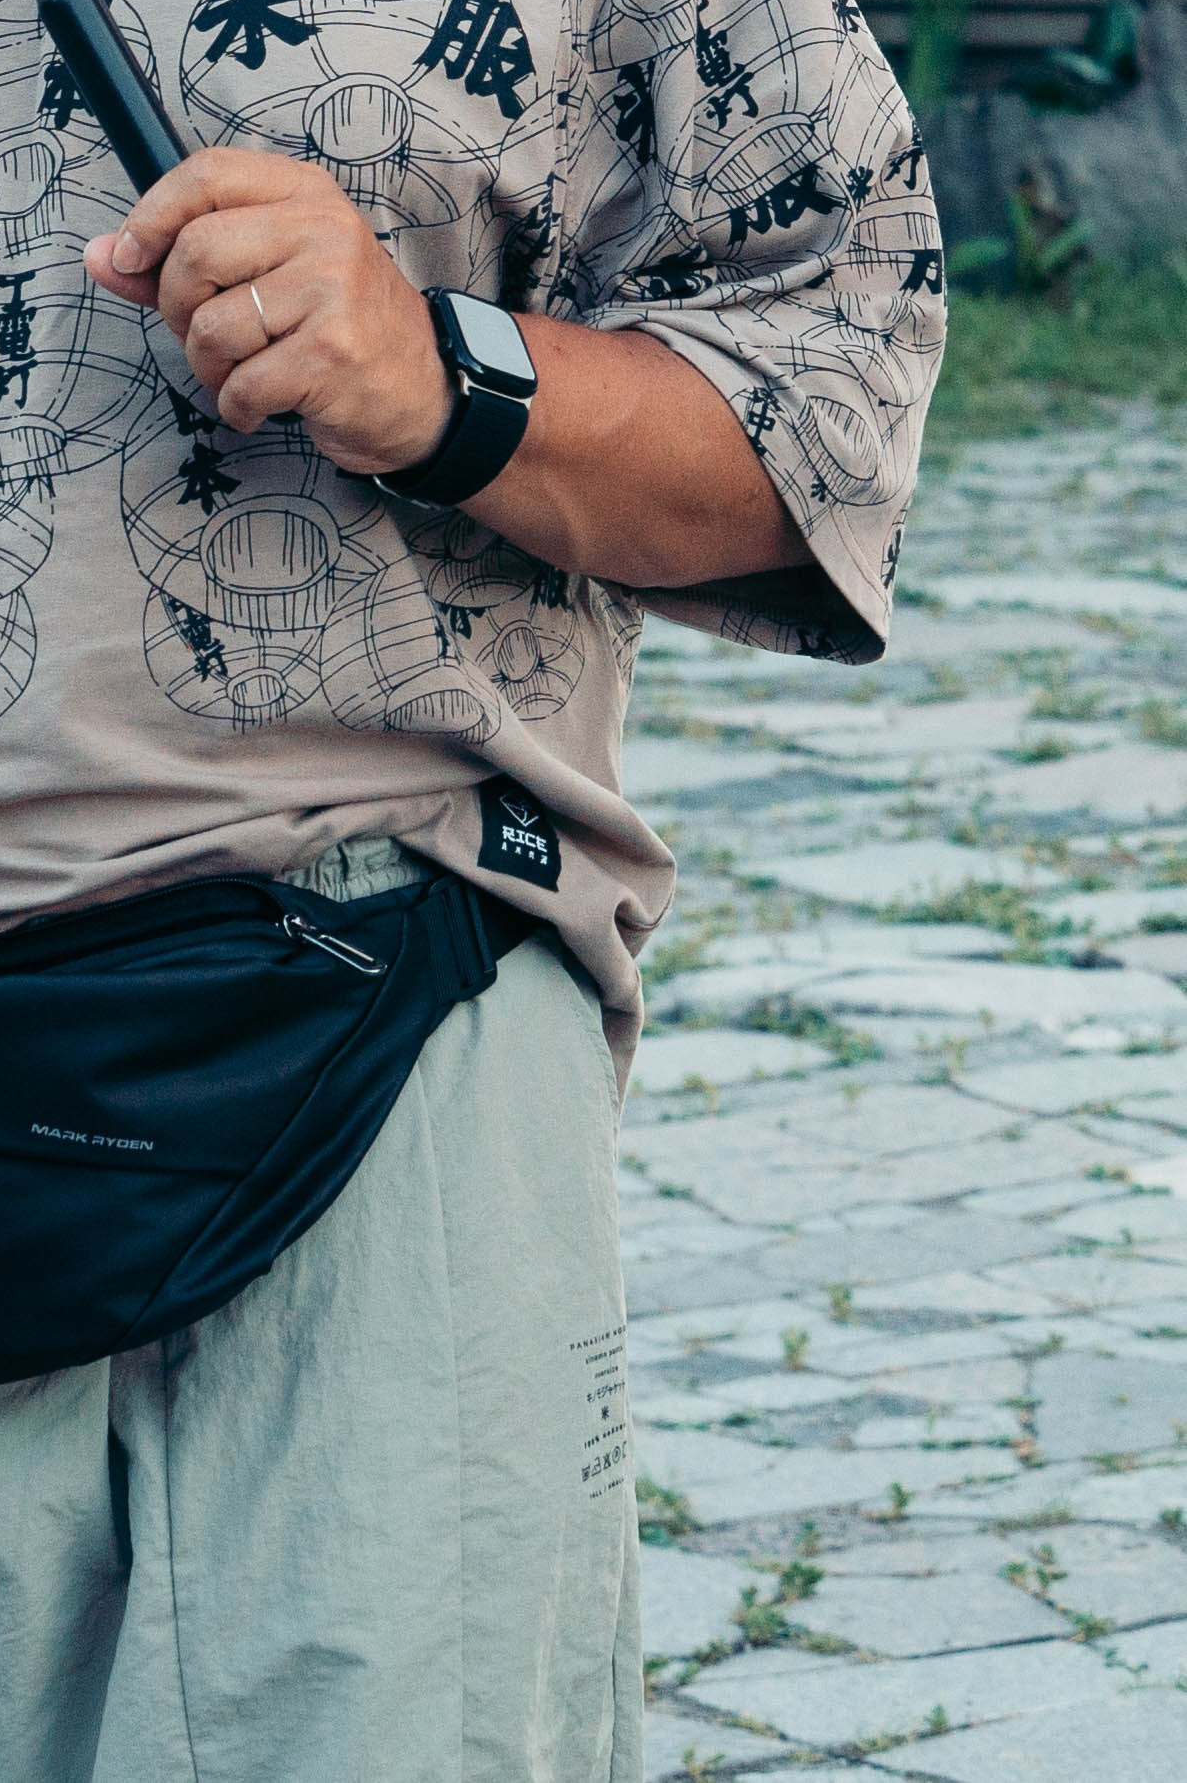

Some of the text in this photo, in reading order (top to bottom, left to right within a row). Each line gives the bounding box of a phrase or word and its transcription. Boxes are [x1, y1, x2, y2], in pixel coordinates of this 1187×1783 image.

[502, 825, 547, 853] RICE
[31, 1123, 154, 1151] MARK RYDEN
